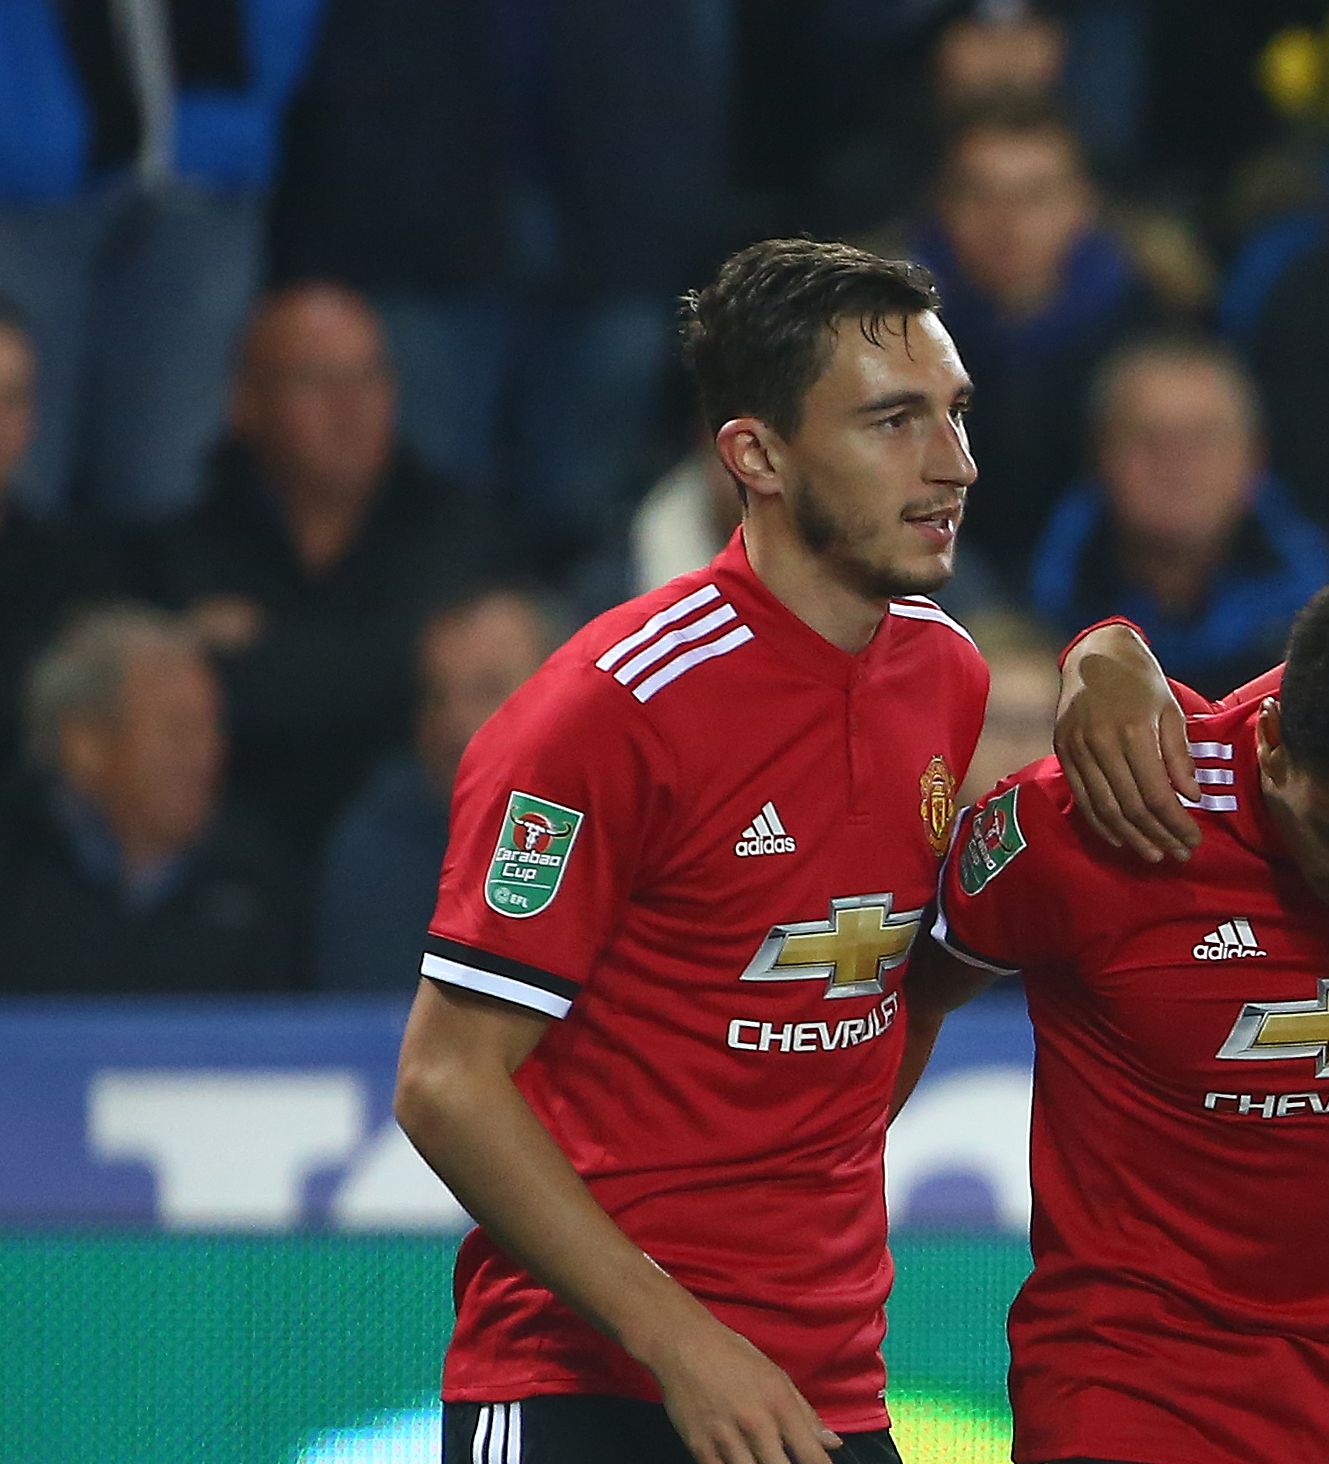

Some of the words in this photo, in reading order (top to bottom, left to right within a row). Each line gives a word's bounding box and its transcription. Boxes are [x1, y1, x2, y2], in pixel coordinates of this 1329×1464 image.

[735, 834, 796, 857] adidas
[495, 847, 562, 866] Carabao
[502, 862, 537, 882] Cup
[510, 893, 528, 908] EFL
